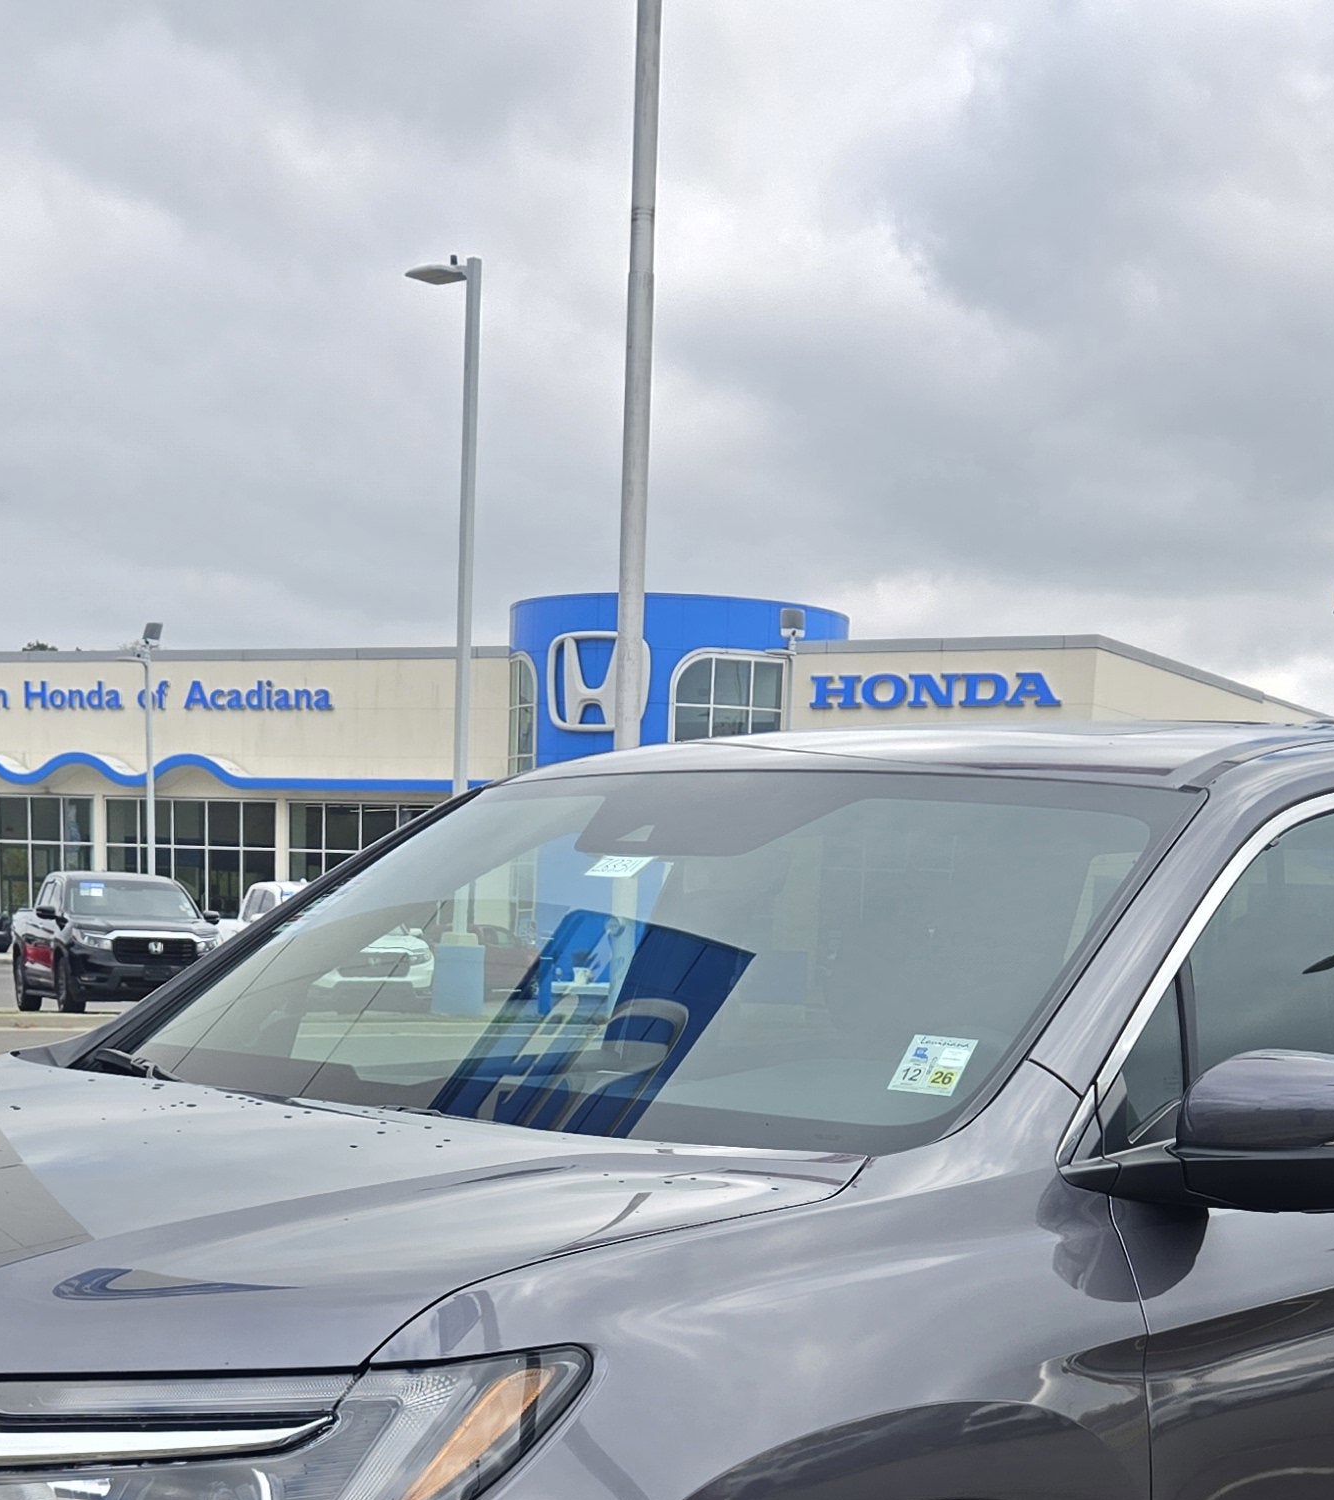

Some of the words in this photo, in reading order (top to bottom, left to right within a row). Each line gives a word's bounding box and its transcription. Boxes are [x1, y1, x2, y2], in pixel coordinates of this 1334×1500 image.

[23, 680, 124, 711] Honda
[137, 680, 170, 711] of
[183, 680, 335, 712] Acadiana
[809, 671, 1062, 709] HONDA
[901, 1067, 922, 1082] 12
[930, 1070, 955, 1085] 26
